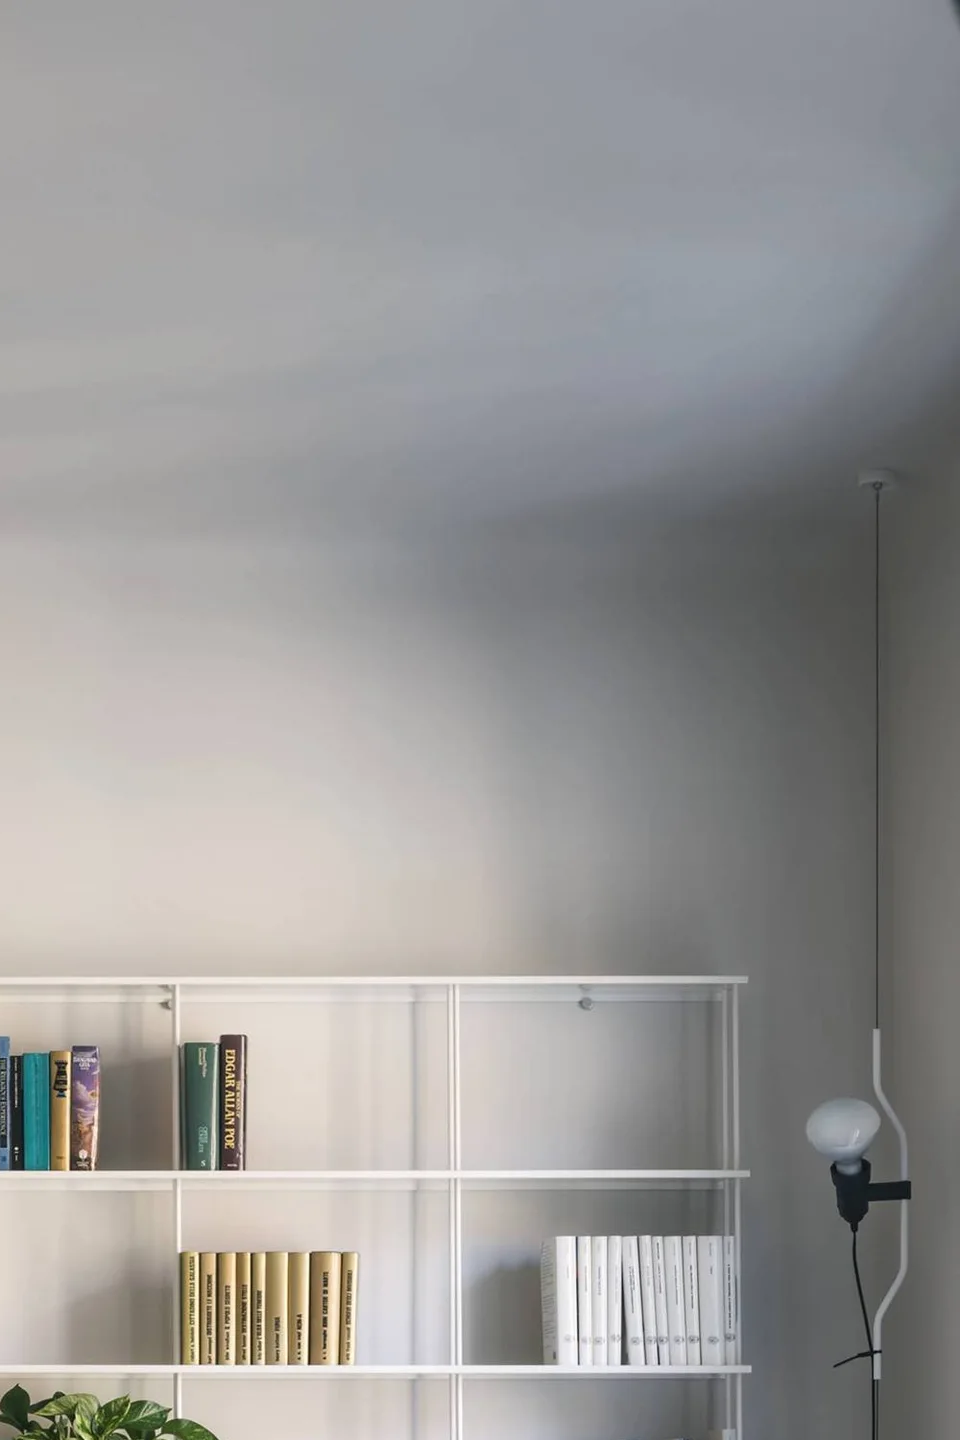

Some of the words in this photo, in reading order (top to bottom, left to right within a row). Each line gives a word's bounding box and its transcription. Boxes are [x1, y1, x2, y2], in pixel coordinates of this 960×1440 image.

[224, 1049, 236, 1087] EDGAR
[224, 1089, 236, 1126] ALLAN
[224, 1128, 236, 1150] POE
